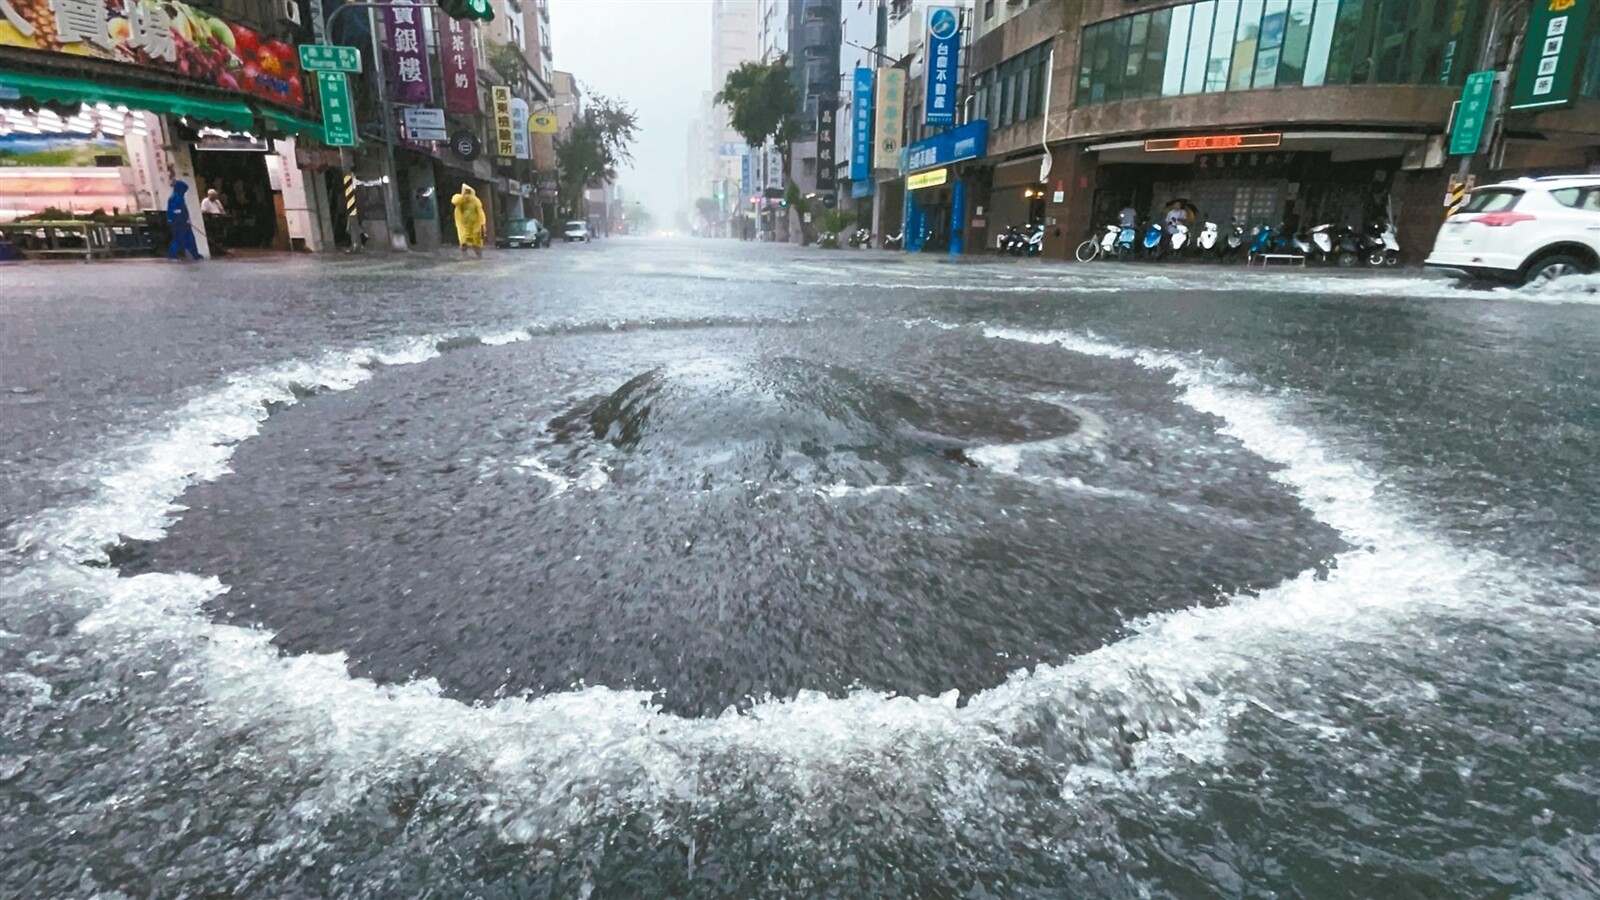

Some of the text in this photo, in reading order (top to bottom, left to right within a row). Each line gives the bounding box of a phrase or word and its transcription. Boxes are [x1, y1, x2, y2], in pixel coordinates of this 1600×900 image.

[0, 0, 177, 63] 賣場
[448, 17, 469, 88] 紅茶牛奶
[495, 88, 512, 154] 信東檢驗所
